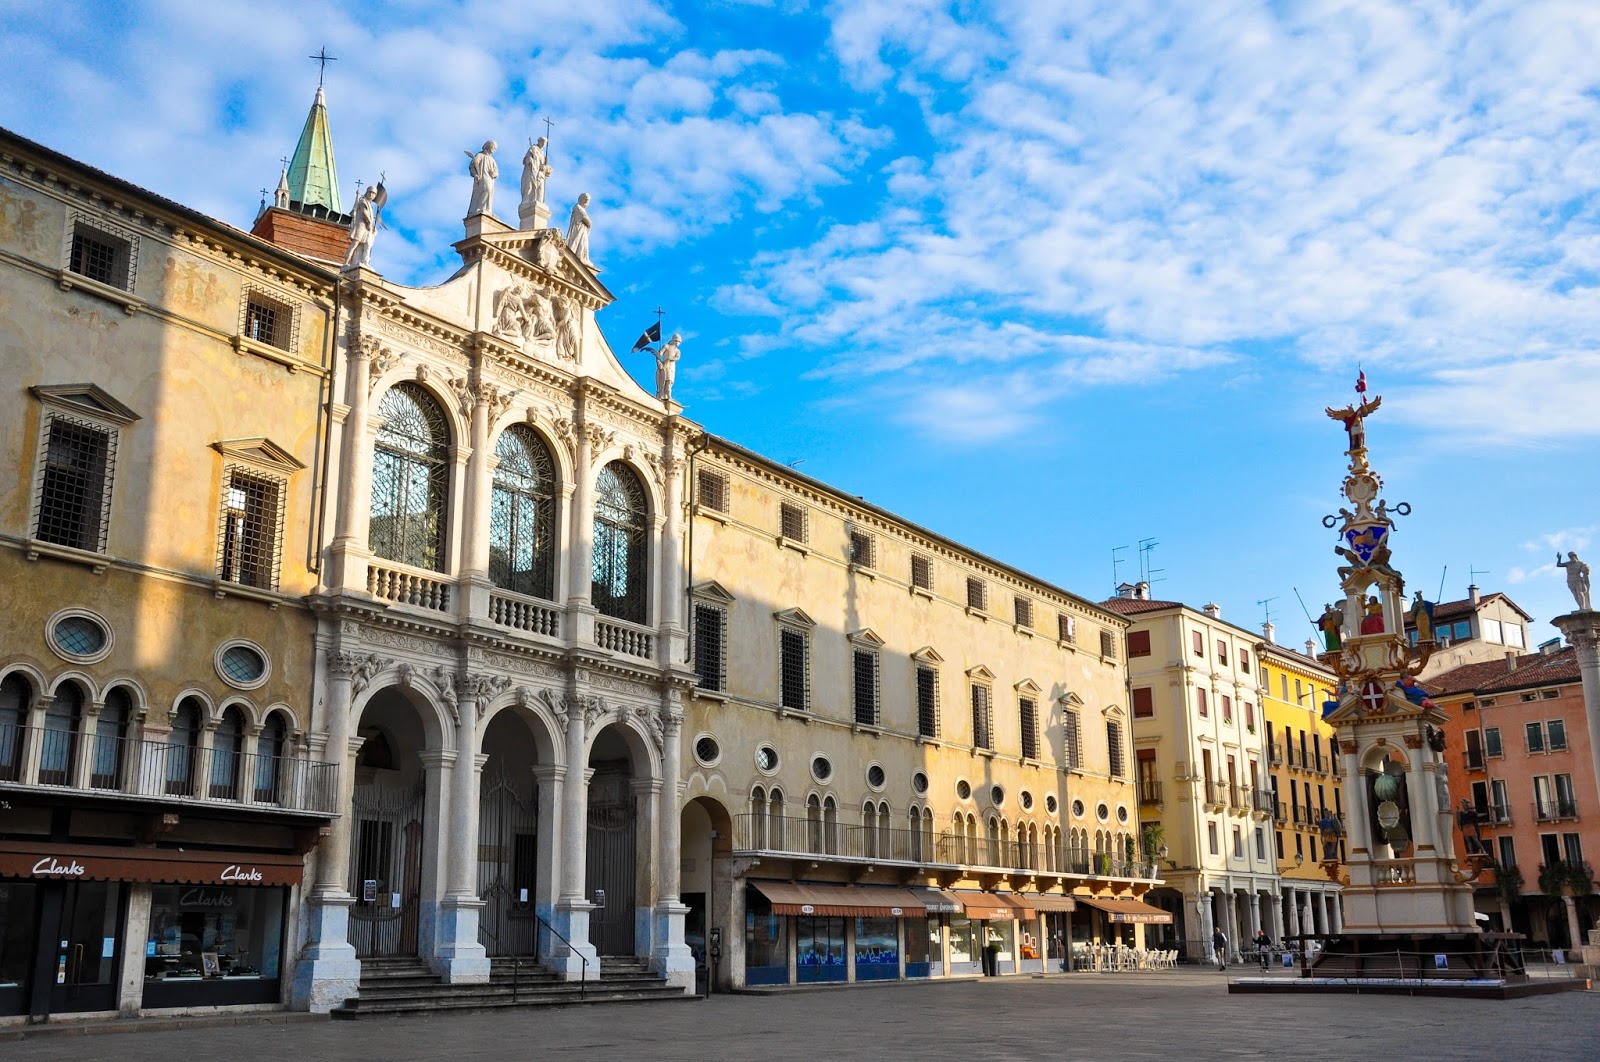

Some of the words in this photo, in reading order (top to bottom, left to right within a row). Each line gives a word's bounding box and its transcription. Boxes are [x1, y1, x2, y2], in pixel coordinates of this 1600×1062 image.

[32, 857, 85, 875] Clarks
[220, 864, 263, 881] Clarks
[179, 888, 233, 906] Clarks
